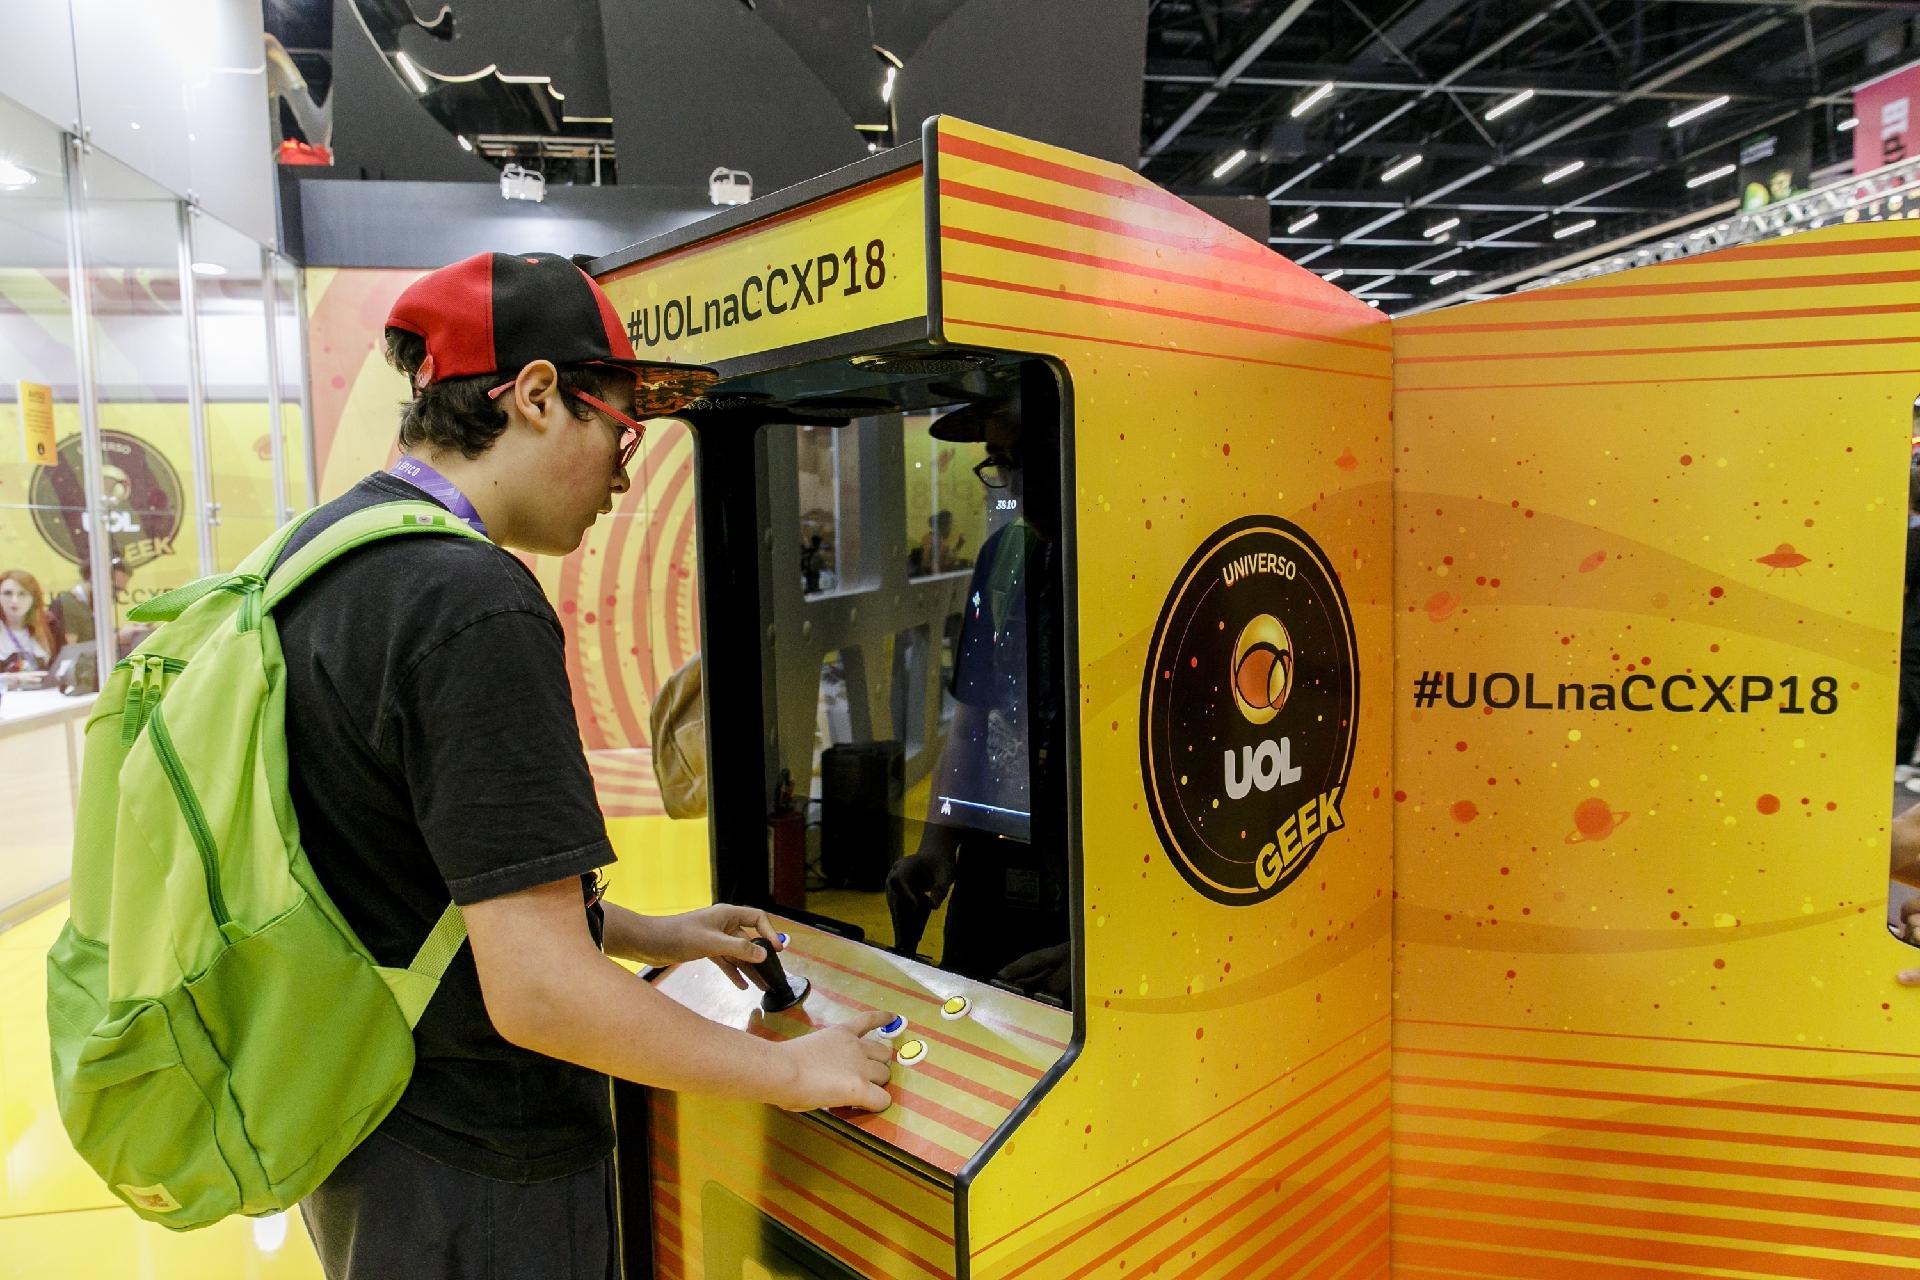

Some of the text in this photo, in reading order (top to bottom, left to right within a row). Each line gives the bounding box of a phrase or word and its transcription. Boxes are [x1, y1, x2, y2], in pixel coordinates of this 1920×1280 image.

[627, 238, 886, 350] #UOLnaCCXP18
[1222, 552, 1296, 586] UNIVERSO
[1413, 670, 1839, 715] #UOLnaCCXP18
[1223, 736, 1302, 800] UOL
[1255, 787, 1344, 891] GEEK
